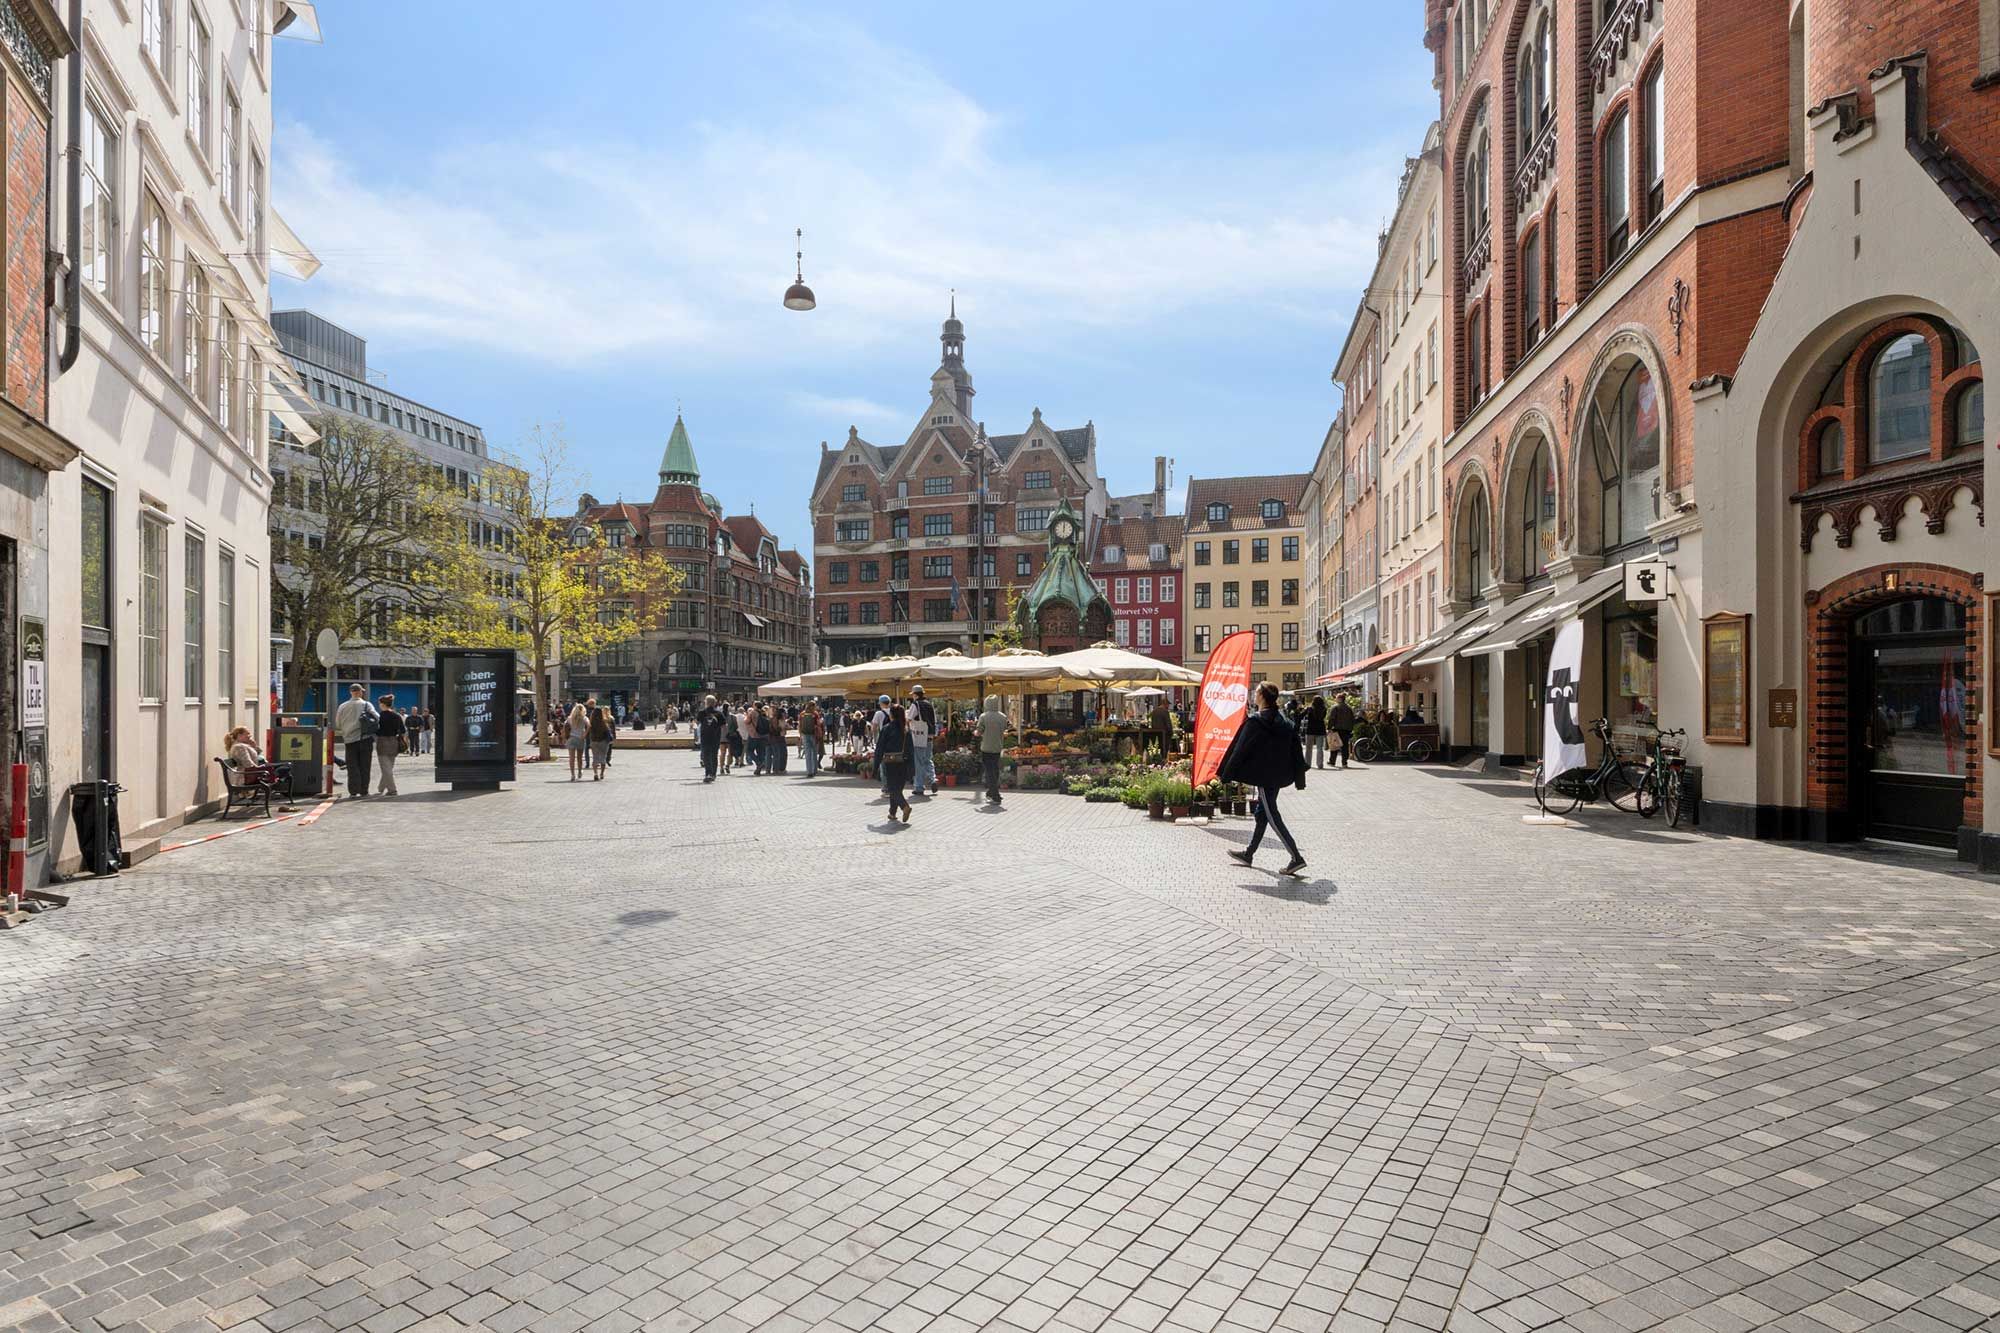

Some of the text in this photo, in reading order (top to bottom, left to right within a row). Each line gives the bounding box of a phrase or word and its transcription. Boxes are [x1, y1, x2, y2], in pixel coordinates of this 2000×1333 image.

[29, 665, 39, 685] TIL
[26, 689, 41, 708] LEJE
[1205, 690, 1245, 702] UDSALG
